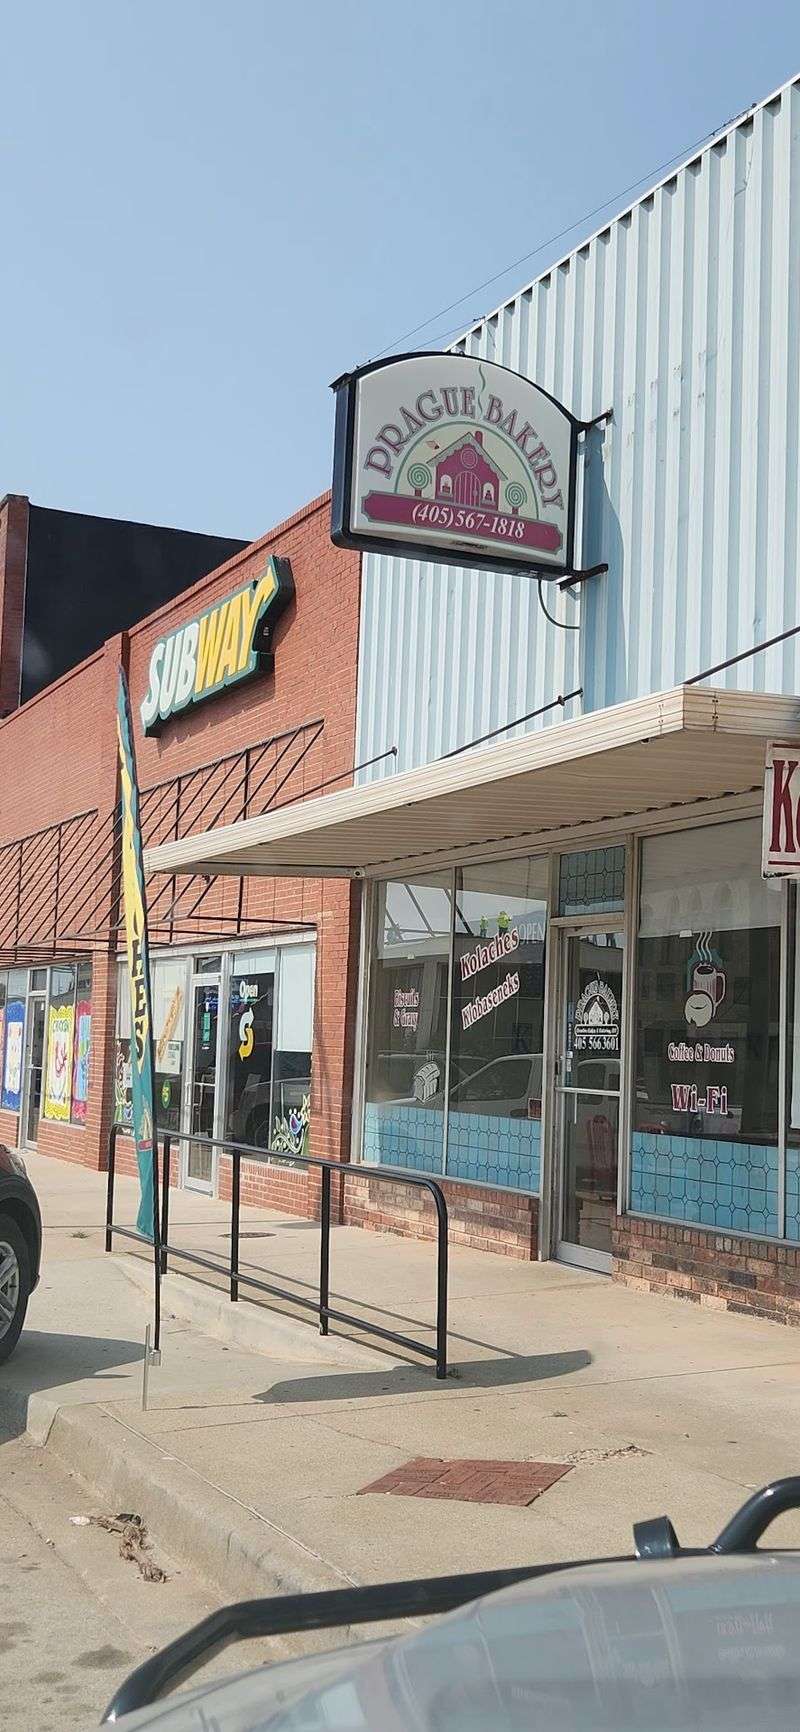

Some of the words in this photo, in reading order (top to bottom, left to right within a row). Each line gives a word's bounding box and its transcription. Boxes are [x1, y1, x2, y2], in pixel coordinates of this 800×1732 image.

[364, 386, 476, 479] PRAGUE
[482, 393, 564, 510] BAKERY
[411, 503, 526, 539] (405)567-1818
[140, 564, 276, 725] SUBWAY
[459, 928, 520, 982] Kolaches
[239, 980, 258, 1003] Open
[668, 1043, 694, 1062] Coffee
[695, 1044, 703, 1062] &
[703, 1044, 735, 1063] Donuts
[671, 1084, 728, 1115] Wi-Fi
